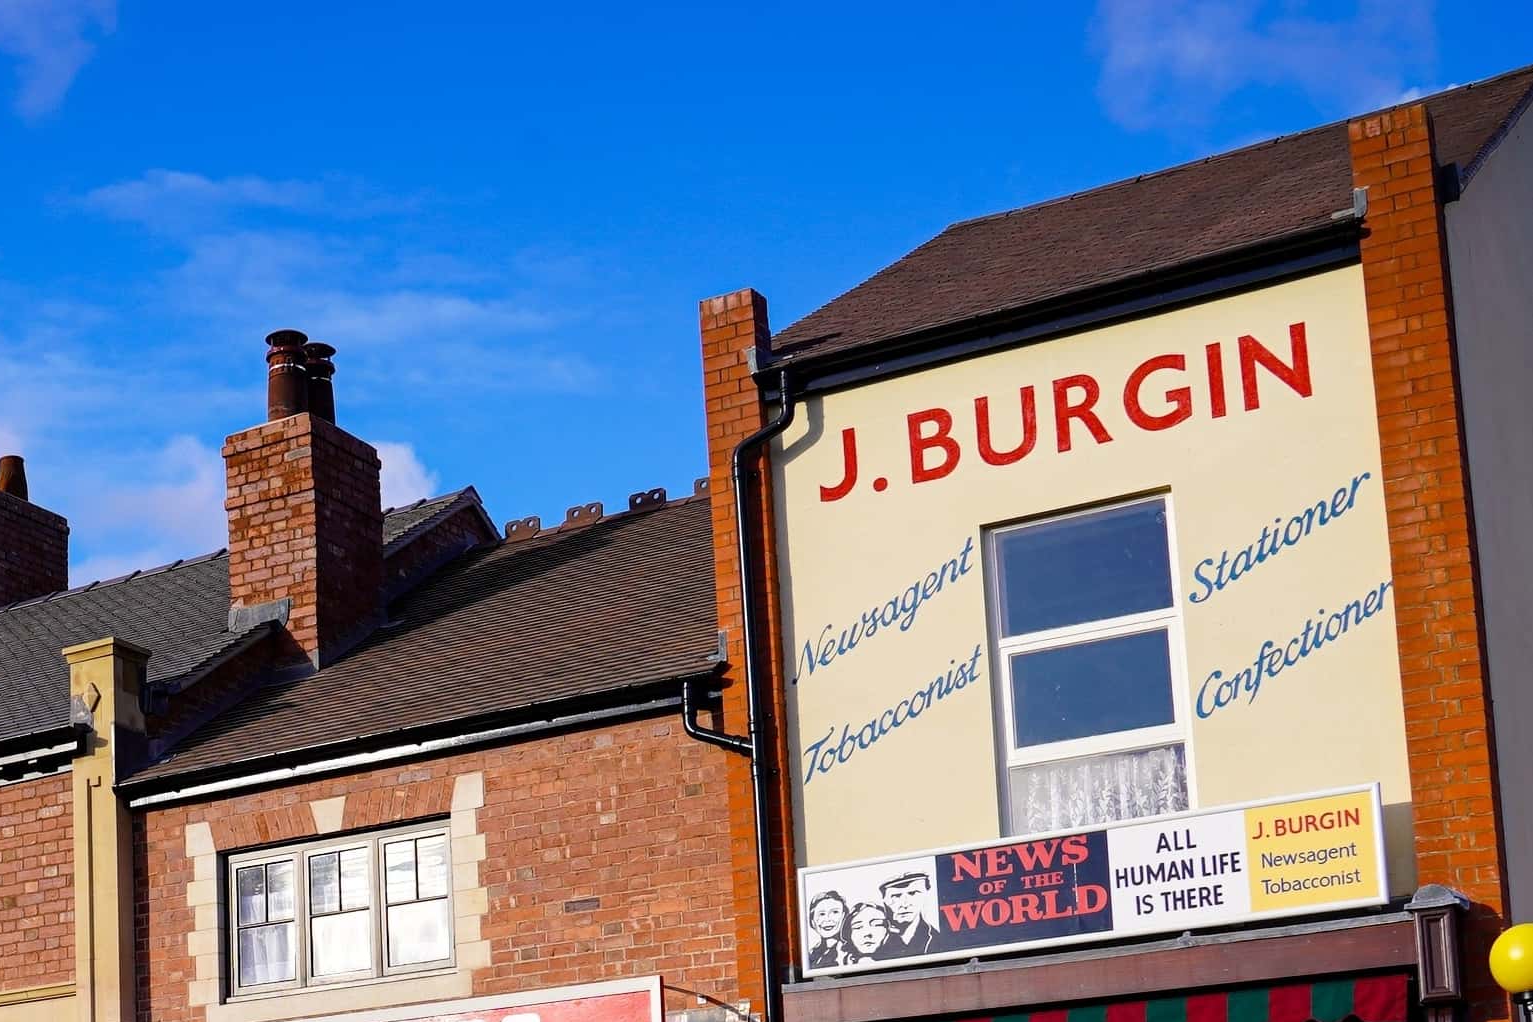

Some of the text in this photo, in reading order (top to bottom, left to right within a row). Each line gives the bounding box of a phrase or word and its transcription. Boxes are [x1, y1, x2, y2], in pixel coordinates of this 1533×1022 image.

[1189, 472, 1371, 604] Stationer
[791, 537, 974, 685] Newsagent
[1196, 580, 1394, 719] Confectioner
[802, 646, 982, 784] Tobacconist
[1156, 829, 1197, 854] ALL
[1251, 807, 1361, 840] J. BURGIN
[950, 834, 1090, 882] NEWS
[1115, 852, 1242, 889] HUMAN LIFE
[1261, 842, 1357, 873] Newsagent
[978, 871, 1064, 896] OF THE
[1135, 885, 1224, 917] IS THERE
[1261, 869, 1361, 896] Tobacconist
[940, 884, 1108, 933] WORLD
